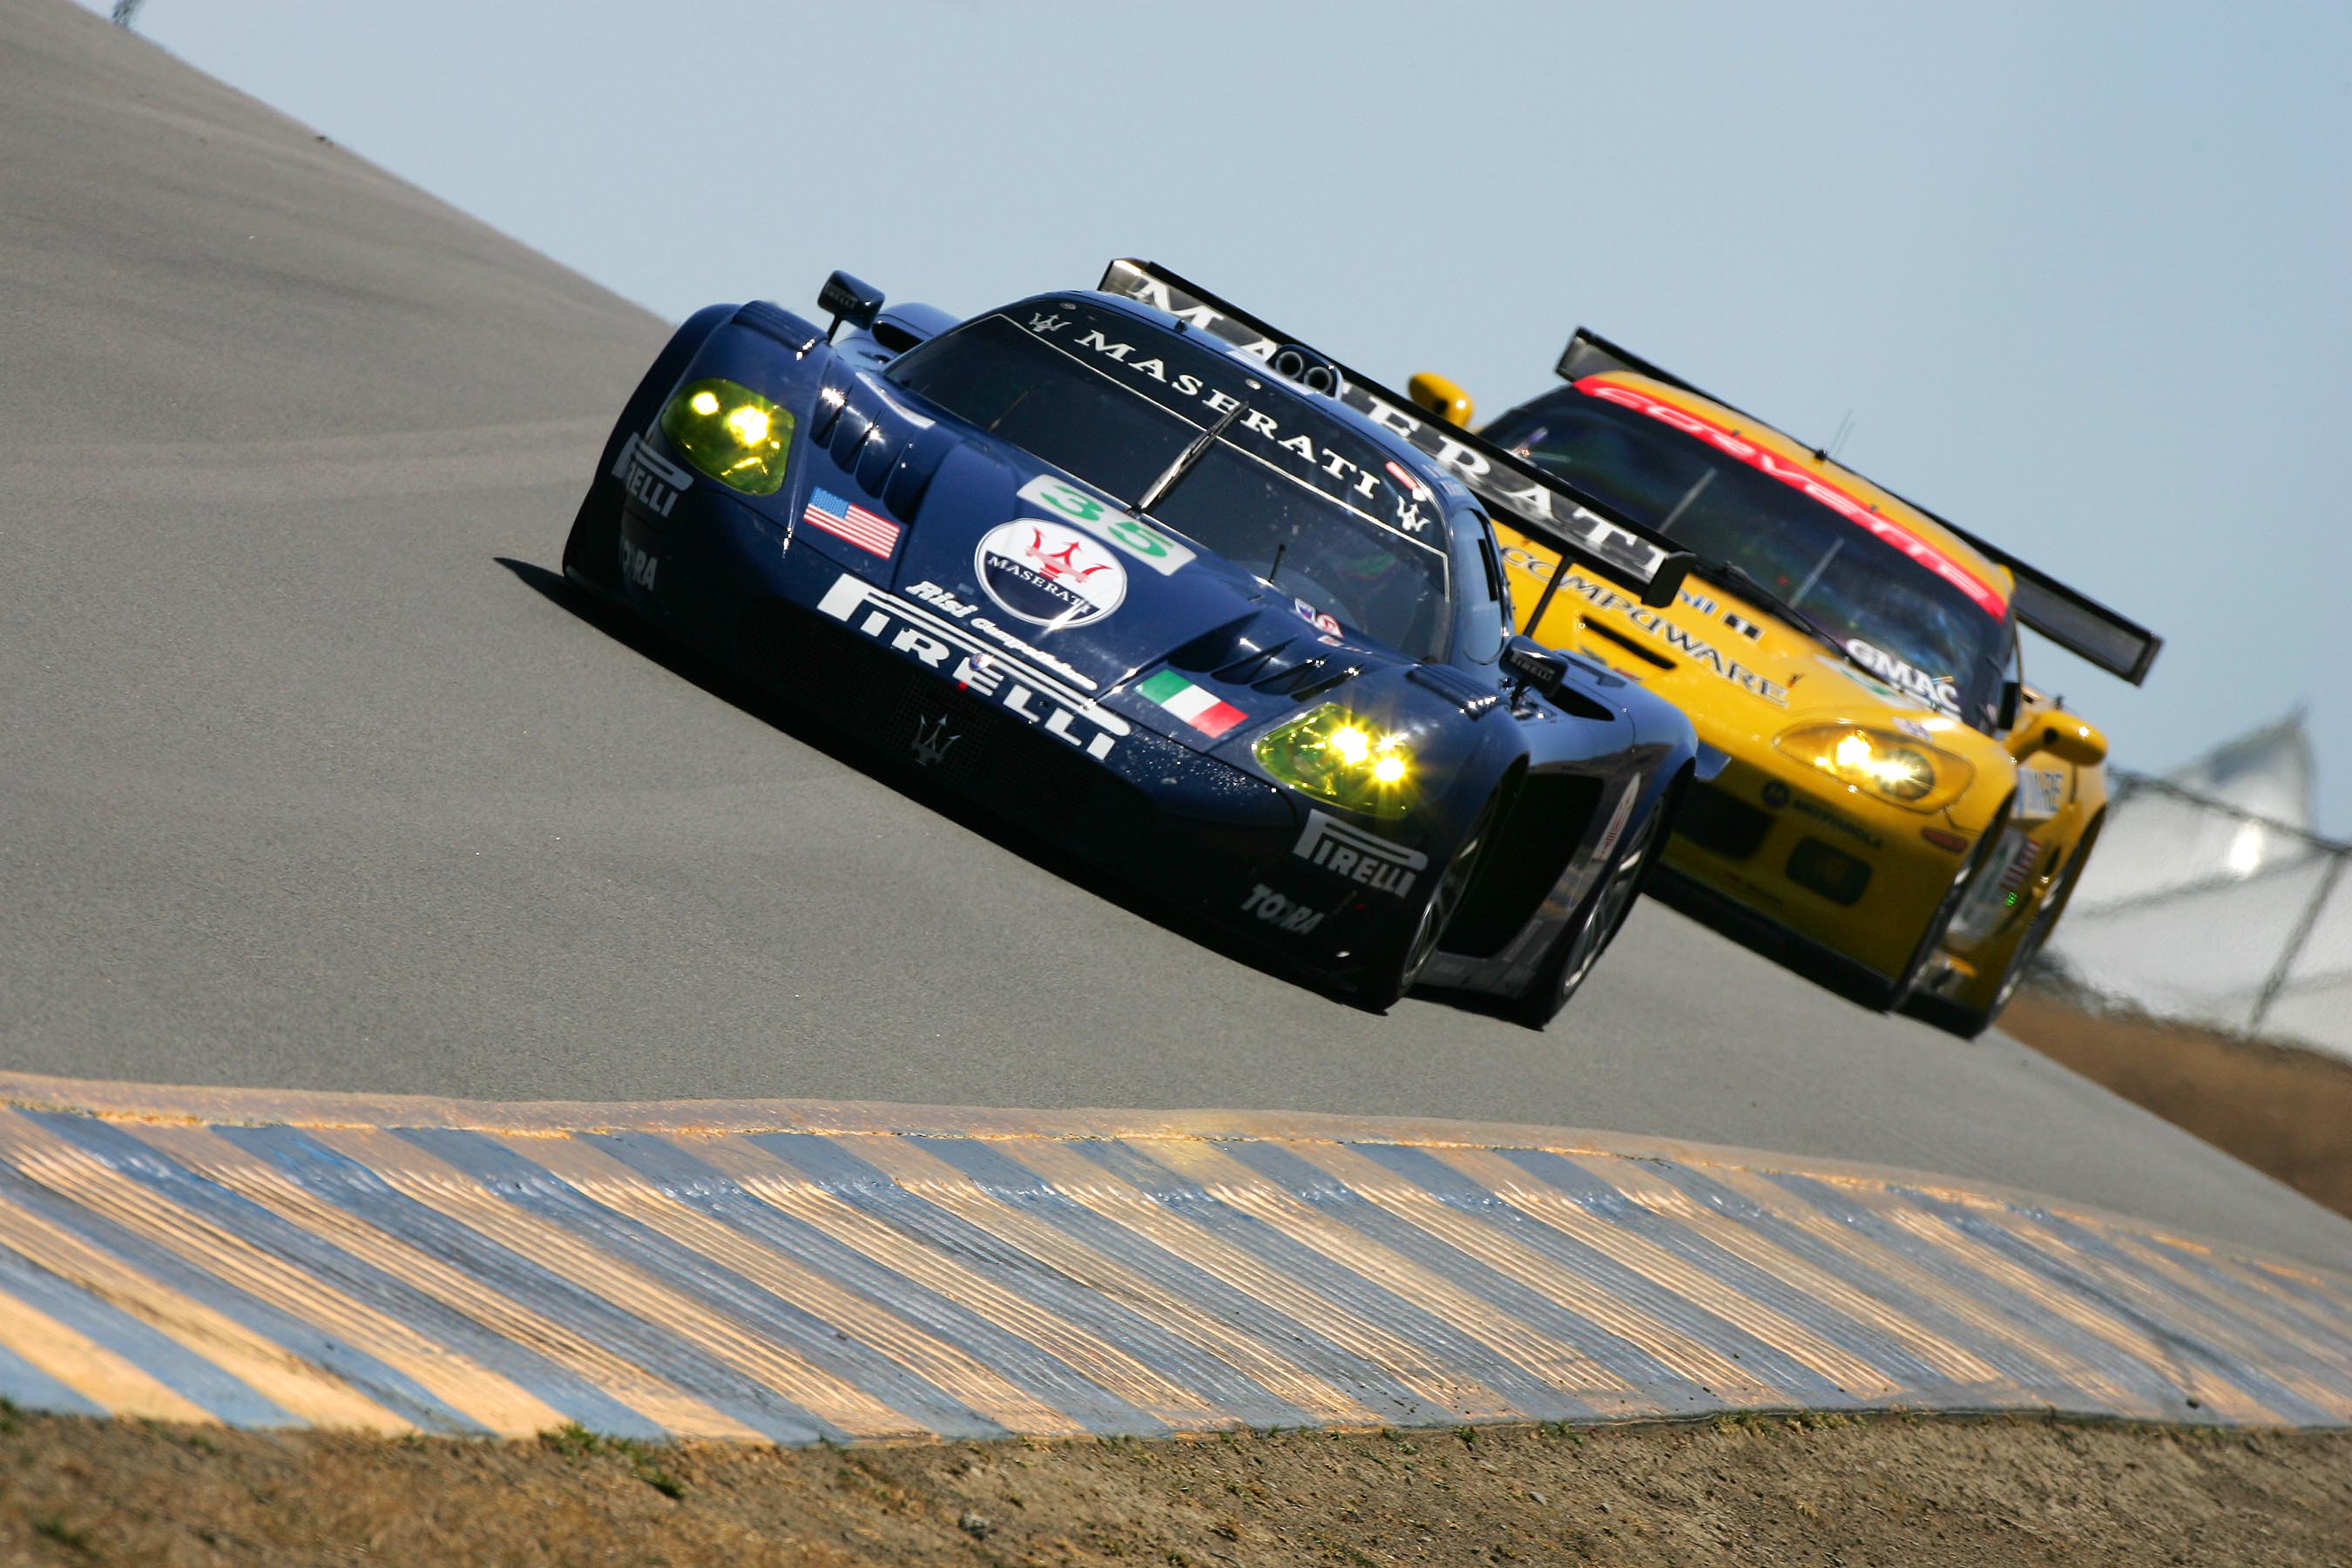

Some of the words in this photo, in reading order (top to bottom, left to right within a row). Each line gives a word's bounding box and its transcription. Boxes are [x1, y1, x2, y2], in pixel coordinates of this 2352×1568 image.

[1073, 328, 1381, 499] MASERATI
[1040, 484, 1174, 558] 35
[905, 581, 979, 618] Risi
[817, 572, 1132, 760] PIRELLI
[1845, 638, 1962, 714] GMAC
[1292, 808, 1429, 899] PIRELLI
